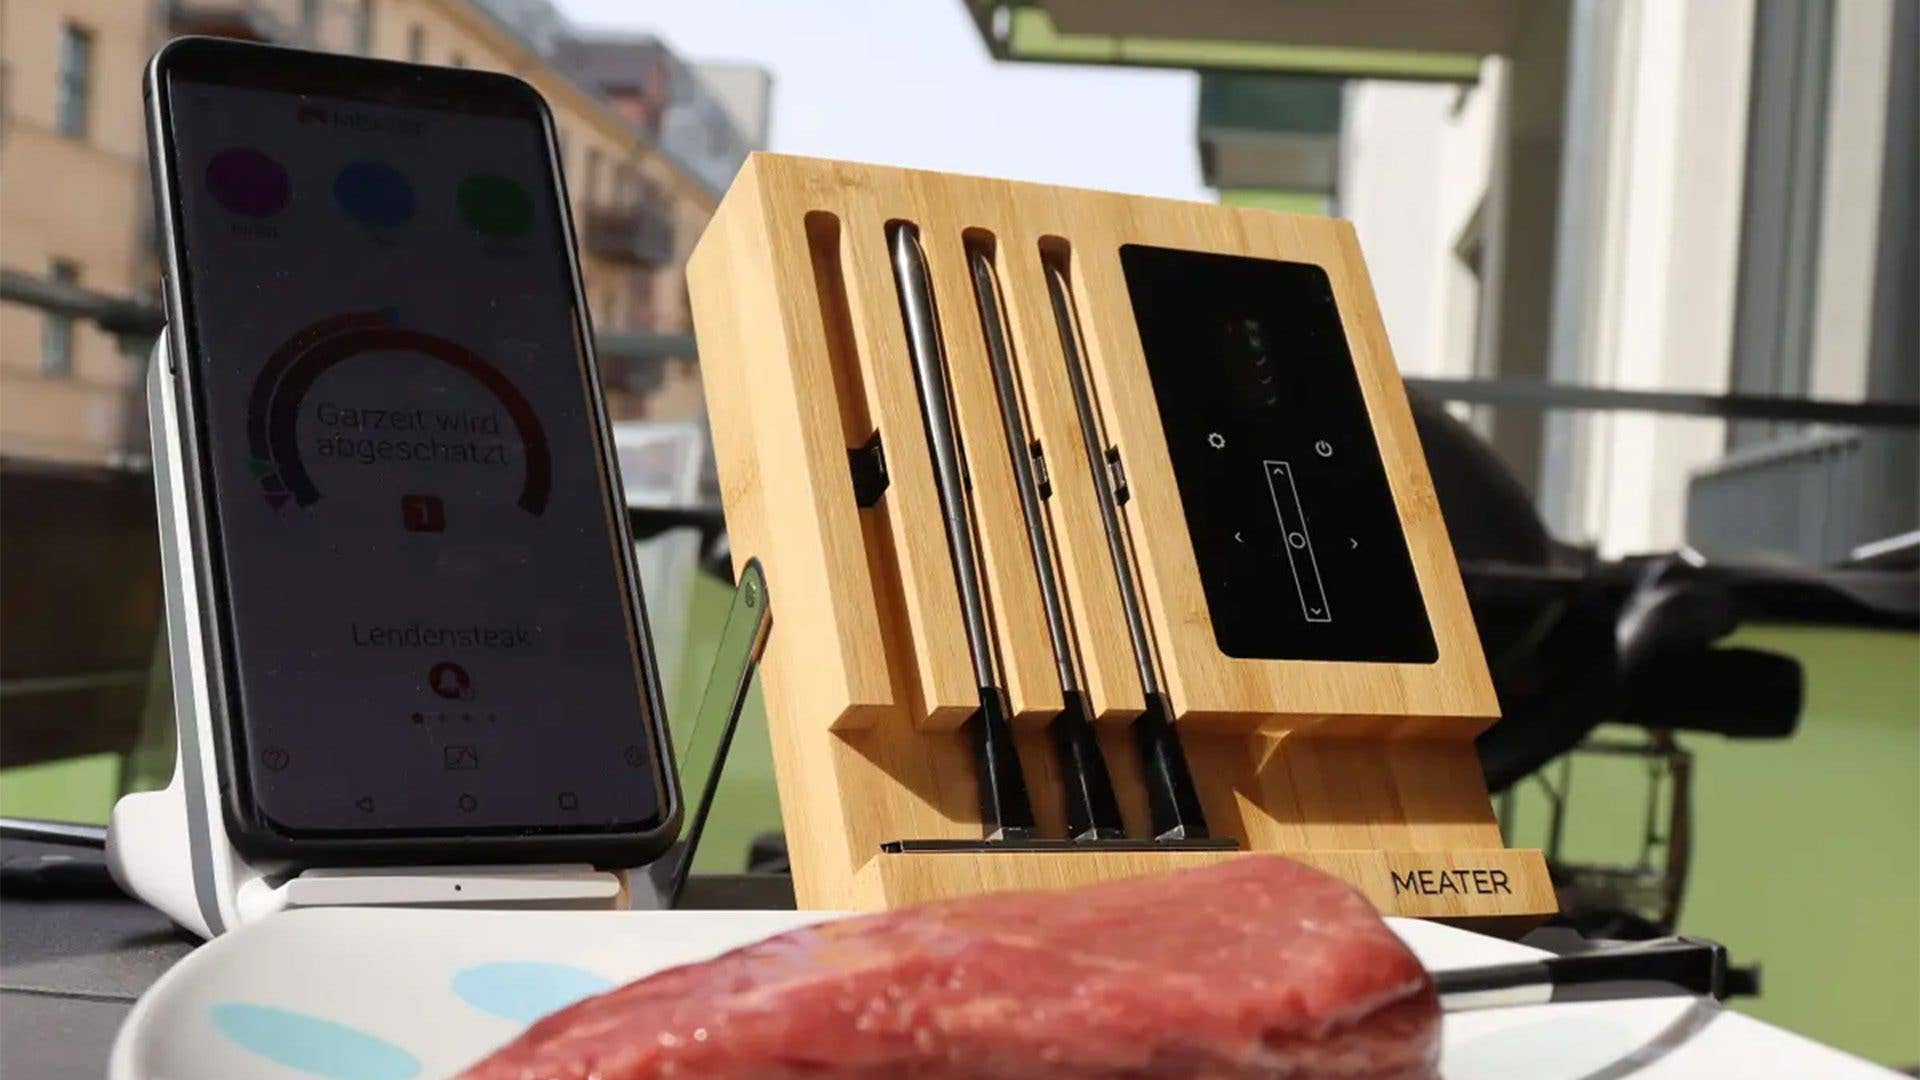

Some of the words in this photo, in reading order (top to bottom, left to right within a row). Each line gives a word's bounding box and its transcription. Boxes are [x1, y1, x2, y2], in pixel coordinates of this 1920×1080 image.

[317, 401, 425, 430] Garzeit
[435, 408, 499, 434] wird
[352, 623, 532, 648] Lendensteak
[1391, 869, 1512, 895] MEATER
